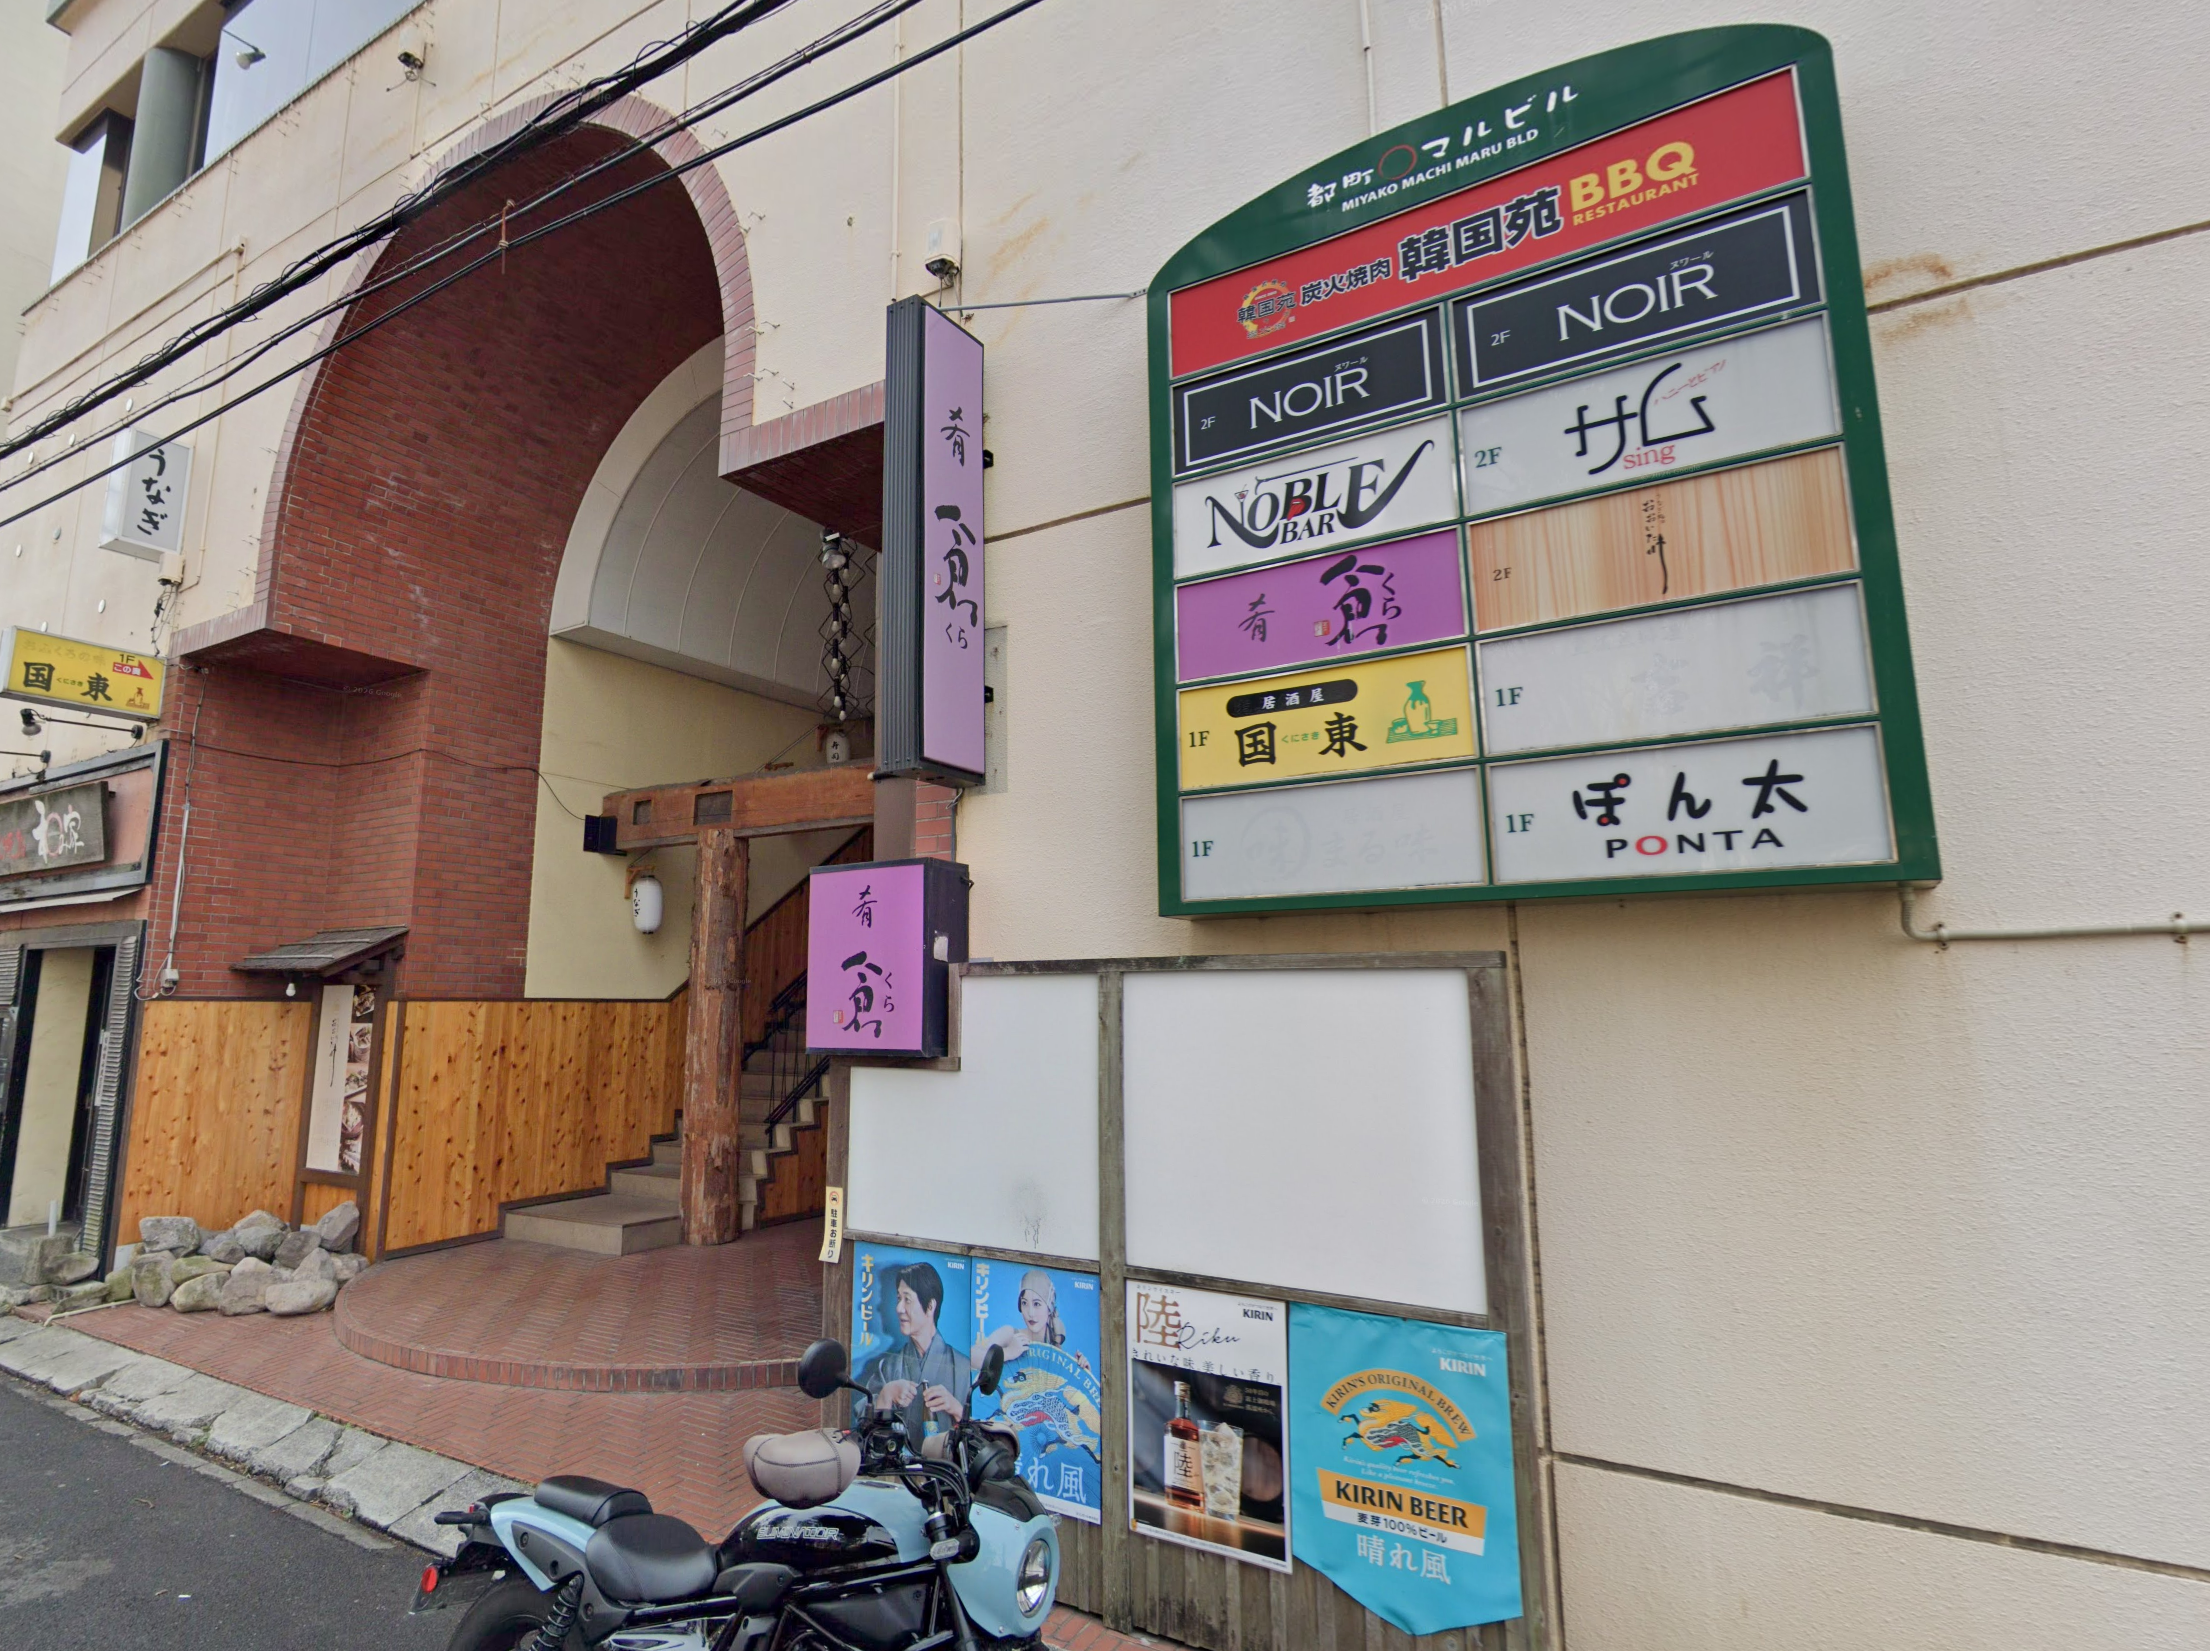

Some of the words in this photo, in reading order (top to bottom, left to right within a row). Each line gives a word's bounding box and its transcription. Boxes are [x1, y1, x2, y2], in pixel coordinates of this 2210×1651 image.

[1307, 169, 1373, 208] 都町
[1421, 86, 1578, 158] マルビル
[1341, 184, 1398, 212] MIYAKO
[1401, 163, 1451, 190] MACHI
[1455, 143, 1501, 170] MARU
[1506, 129, 1538, 150] BLD
[1569, 141, 1698, 212] BBQ
[1572, 173, 1700, 226] RESTAURANT
[1300, 257, 1392, 306] 炭火焼肉
[1397, 186, 1564, 282] 韓国苑
[1236, 291, 1297, 323] 韓国苑
[1557, 263, 1718, 341] NOIR
[1491, 330, 1511, 347] 2F
[1249, 367, 1371, 430] NOIR
[1200, 416, 1216, 430] 2F
[1474, 446, 1503, 469] 2F
[1622, 444, 1676, 471] sing
[137, 448, 171, 536] うなぎ
[1204, 439, 1435, 549] NOBLE
[1280, 512, 1336, 545] BAR
[1492, 566, 1512, 582] 2F
[1381, 572, 1402, 620] くら
[945, 622, 968, 650] くら
[119, 653, 136, 664] 1F
[23, 661, 113, 701] 国東
[56, 677, 84, 687] くにさき
[1495, 686, 1523, 707] 1F
[1262, 687, 1324, 711] 居酒屋
[1188, 730, 1210, 748] 1F
[1234, 712, 1368, 767] 国東
[1280, 730, 1320, 744] くにさき
[1572, 758, 1809, 826] ぽん太
[1506, 813, 1535, 833] 1F
[1192, 840, 1214, 857] 1F
[1606, 828, 1785, 859] PONTA
[883, 971, 895, 1012] くら
[827, 1208, 838, 1259] 駐車お断り
[947, 1261, 965, 1270] KIRIN
[859, 1253, 875, 1347] キリンビール
[1074, 1281, 1094, 1291] KIRIN
[975, 1263, 990, 1346] キリンビール
[1137, 1292, 1181, 1349] 陸
[1243, 1308, 1274, 1322] KIRIN
[1176, 1321, 1241, 1352] Riku
[1028, 1347, 1081, 1380] RIGINAL
[1439, 1357, 1487, 1377] KIRIN
[1326, 1376, 1367, 1409] KIRIN'S
[1367, 1373, 1435, 1401] ORIGINAL
[1437, 1397, 1472, 1436] BREW
[1014, 1453, 1087, 1504] れ風
[1174, 1451, 1193, 1478] 陸
[1335, 1479, 1403, 1512] KIRIN
[1410, 1496, 1469, 1529] BEER
[757, 1526, 839, 1541] ELIMINATOR
[1357, 1512, 1448, 1544] 麦芽100%ビール
[1356, 1533, 1452, 1585] 晴れ風
